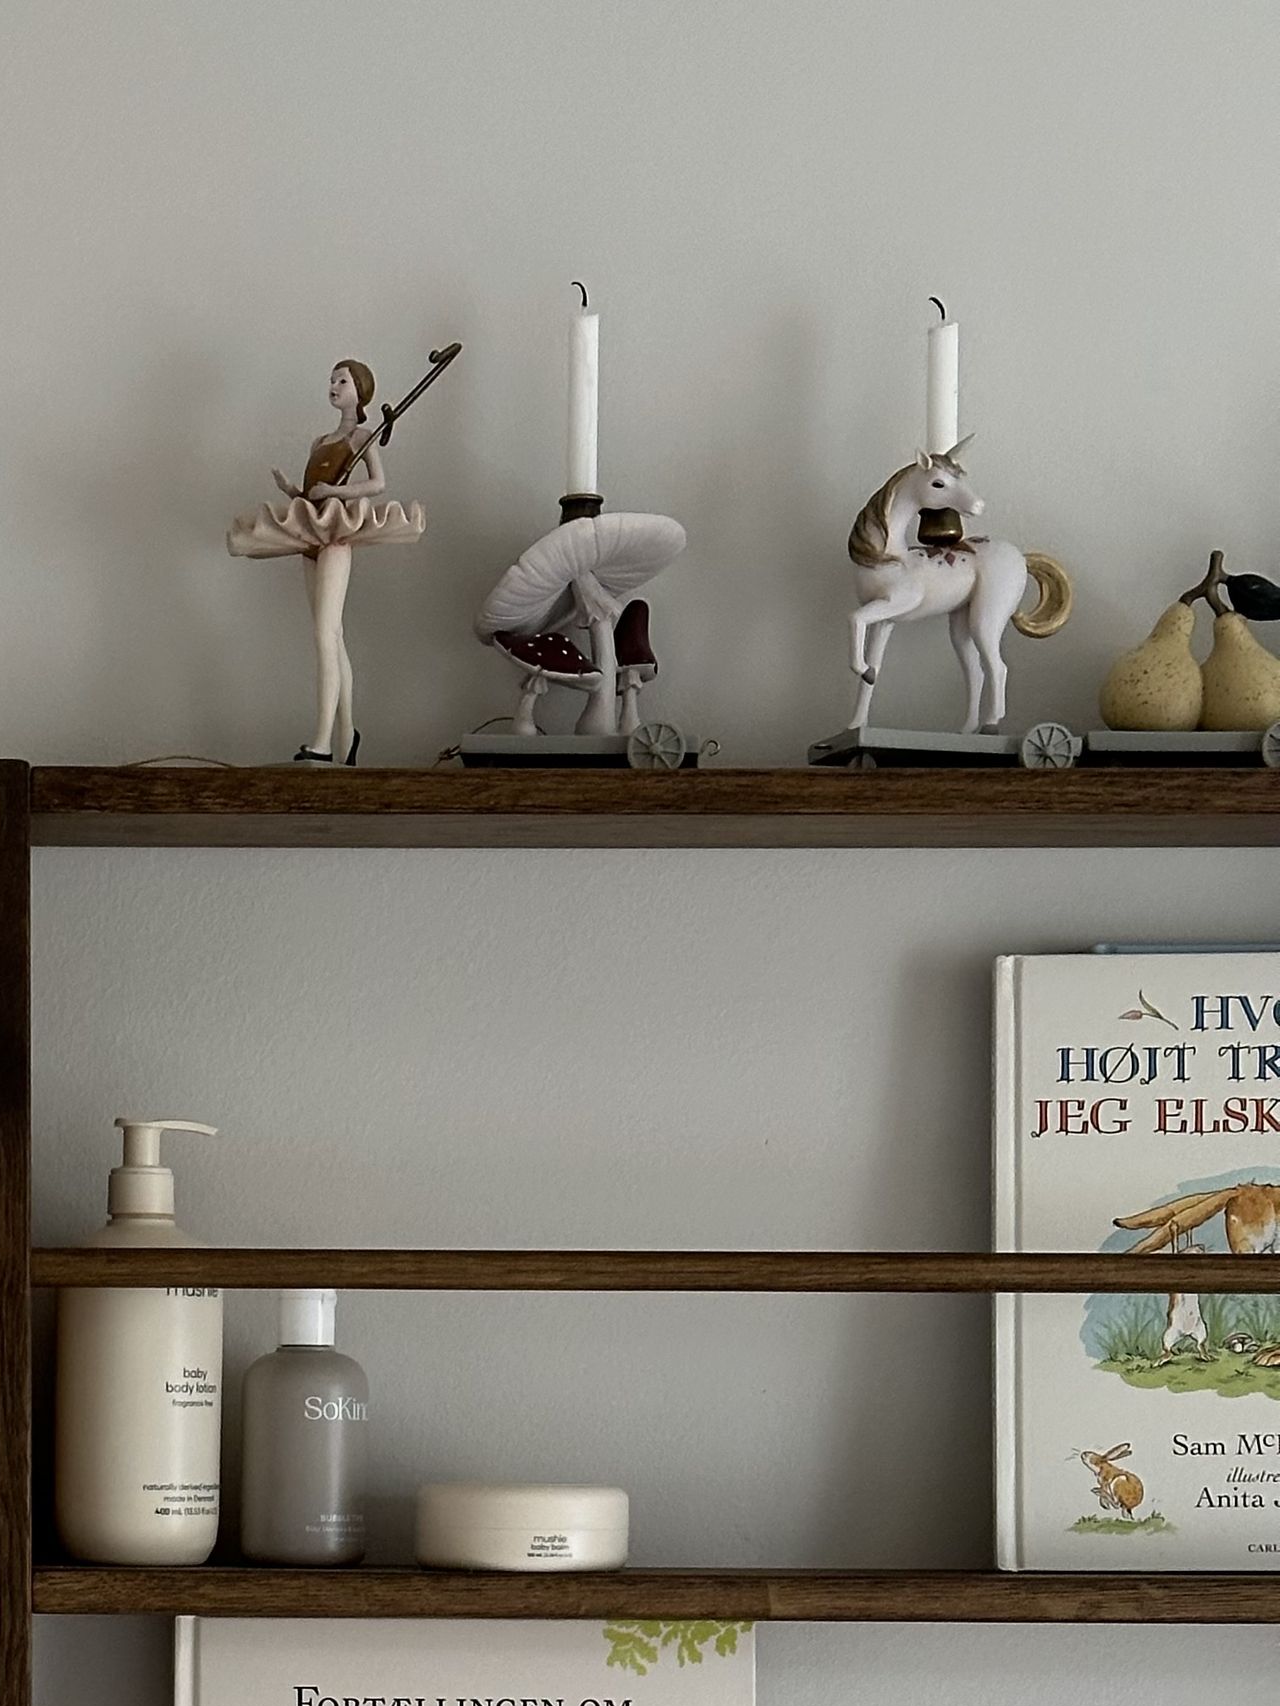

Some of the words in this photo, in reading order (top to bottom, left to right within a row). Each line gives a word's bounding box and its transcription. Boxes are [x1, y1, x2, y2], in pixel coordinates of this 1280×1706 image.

[1190, 994, 1280, 1032] HV
[1056, 1042, 1196, 1085] HØJT
[1031, 1097, 1132, 1138] JEG
[1153, 1097, 1280, 1137] ELSK
[183, 1367, 208, 1381] baby
[165, 1381, 194, 1395] body
[1172, 1433, 1226, 1456] Sam
[1235, 1433, 1280, 1456] Mc
[1194, 1486, 1265, 1508] Anita
